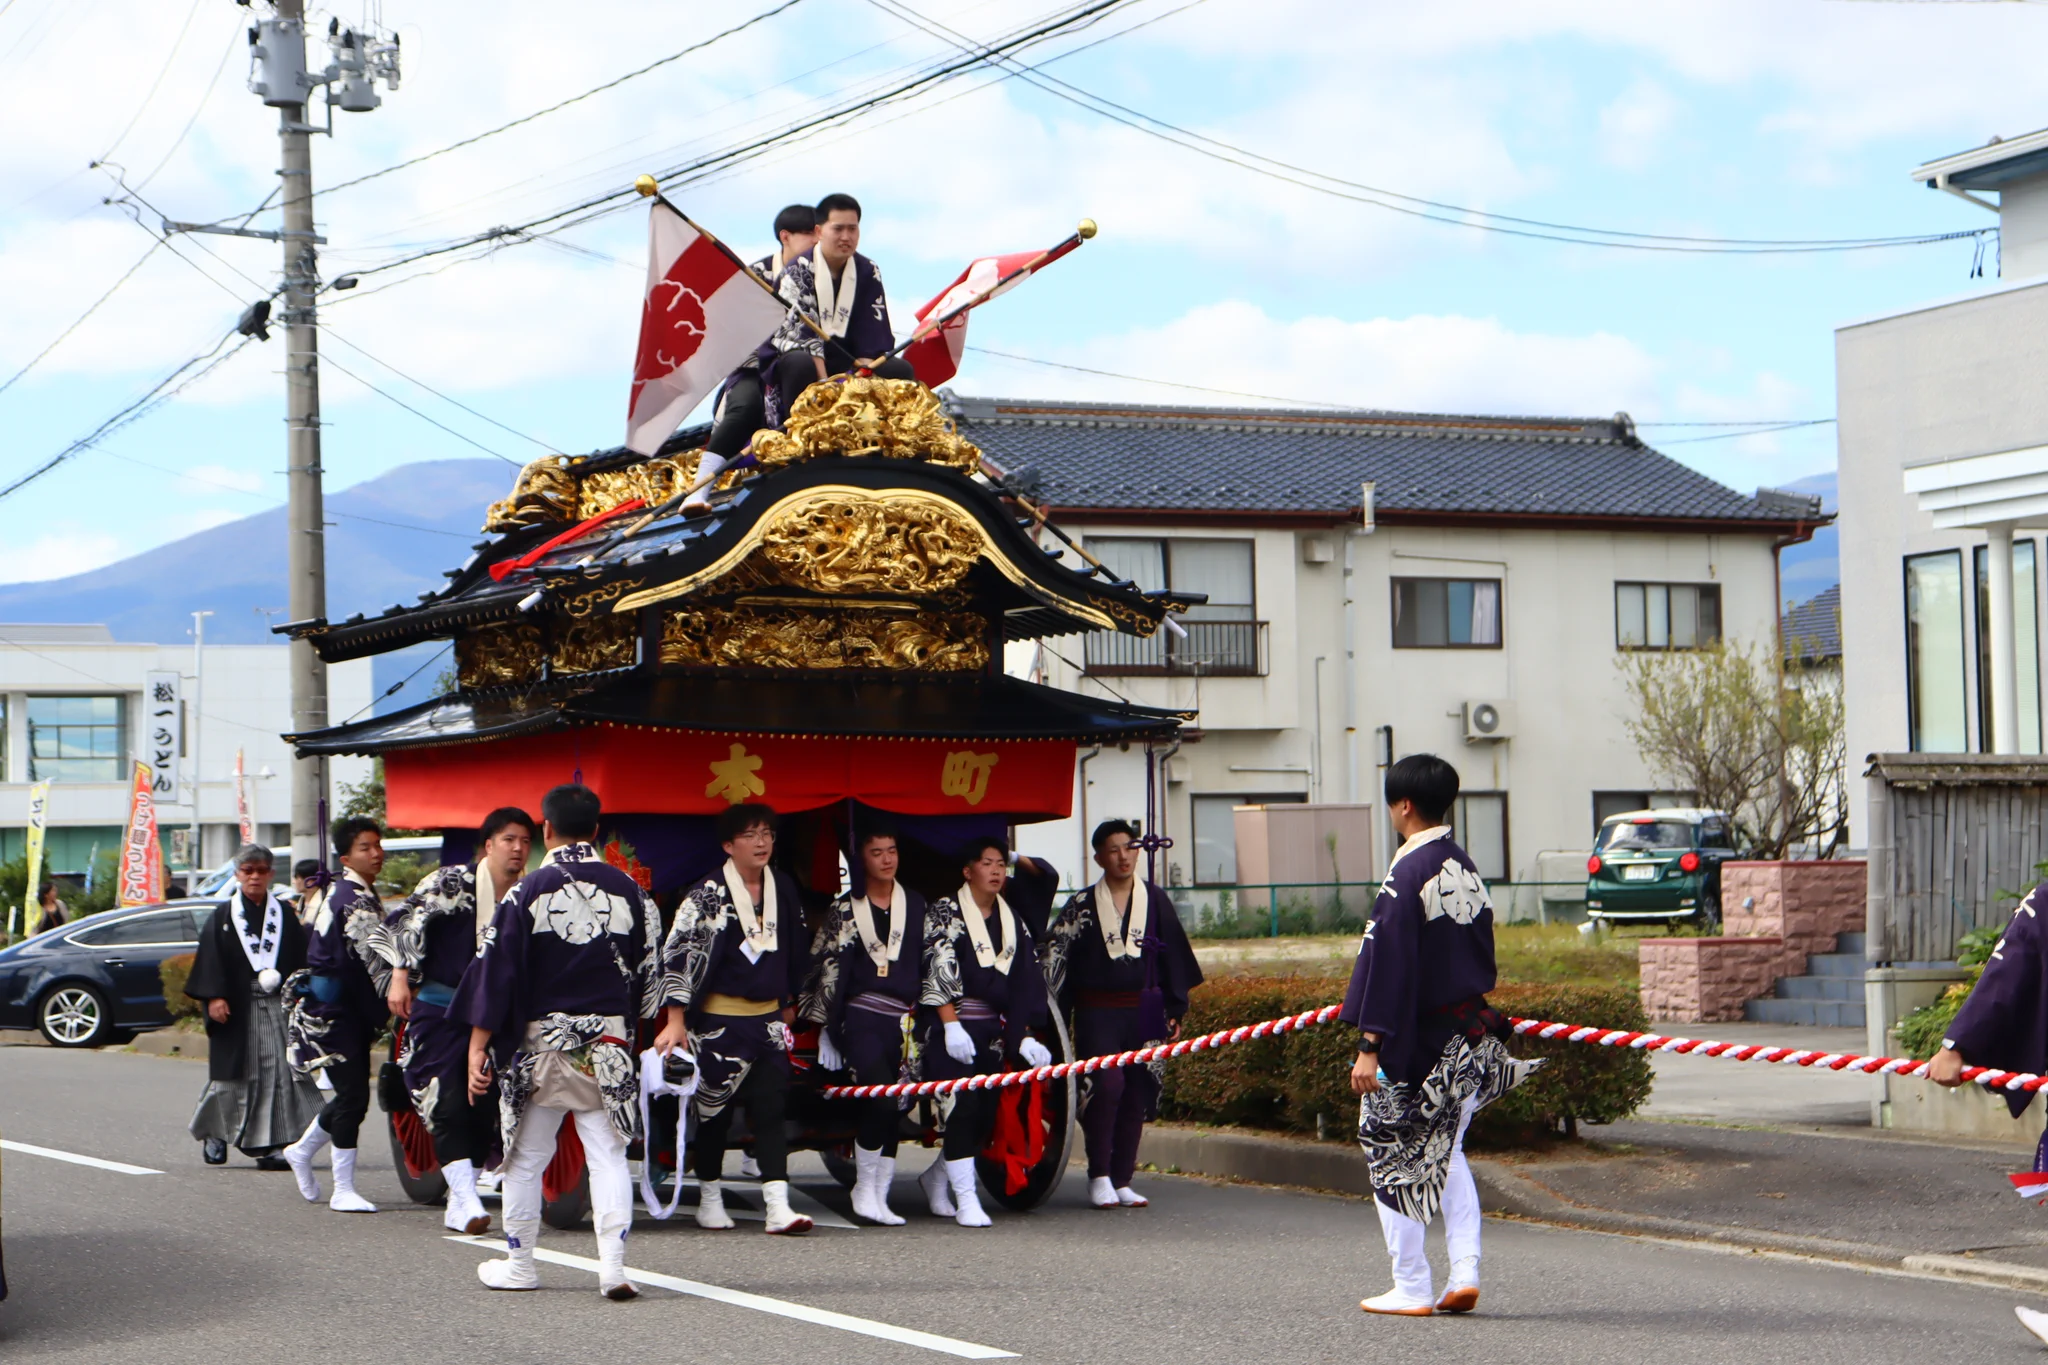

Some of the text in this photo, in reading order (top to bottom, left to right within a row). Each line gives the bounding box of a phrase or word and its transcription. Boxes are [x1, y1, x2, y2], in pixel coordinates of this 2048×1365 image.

[152, 681, 175, 793] 松一うどん
[704, 742, 999, 807] 本 町
